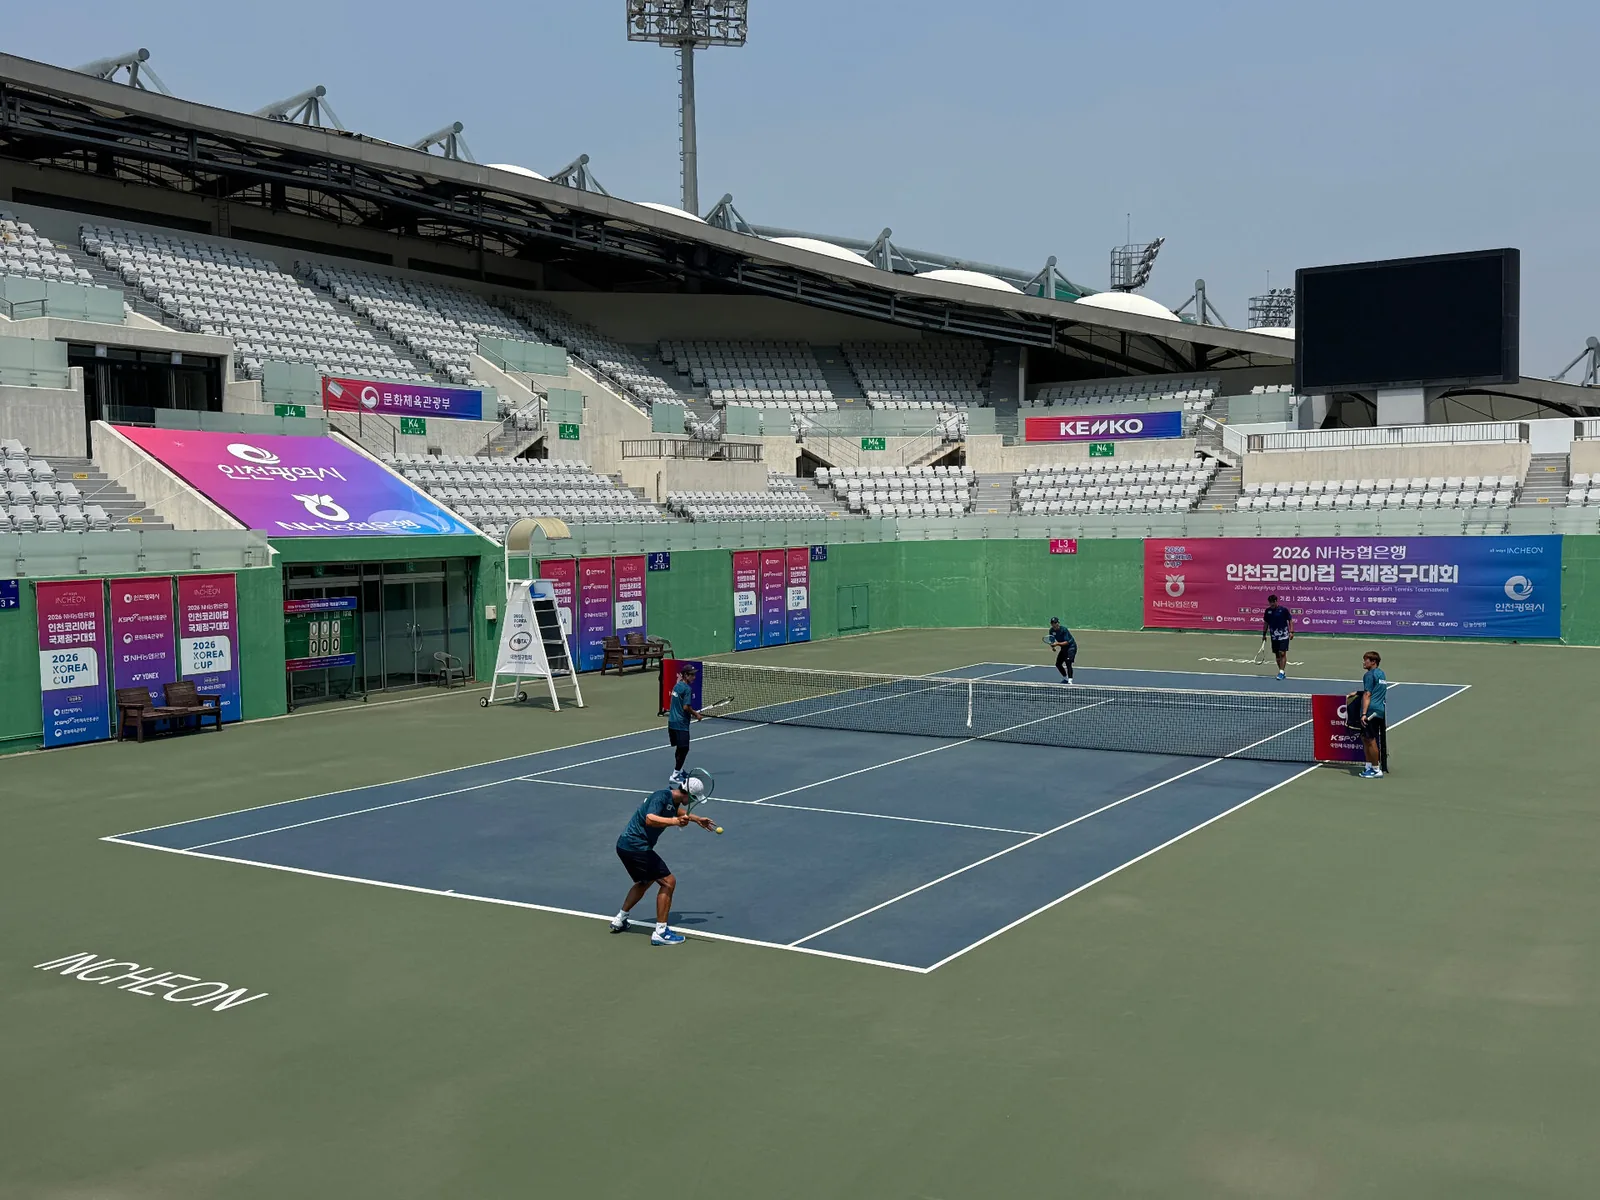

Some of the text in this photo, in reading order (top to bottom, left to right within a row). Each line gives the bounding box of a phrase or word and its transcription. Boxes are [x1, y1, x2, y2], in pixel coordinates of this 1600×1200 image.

[383, 393, 450, 409] 문화체육관광부
[284, 408, 296, 416] J4
[408, 419, 419, 428] K4
[1096, 444, 1107, 452] N4
[218, 464, 347, 482] 인천광역시
[275, 521, 421, 532] NH농협은행
[1058, 539, 1069, 548] L3
[1273, 545, 1407, 560] 2026 NH농협은행
[655, 553, 664, 563] J3
[1226, 563, 1459, 583] 인천코리아컵 국제정구대회
[1152, 600, 1199, 609] NH농협은행
[1495, 603, 1545, 612] 인천광역시
[188, 610, 229, 622] 인천코리아컵
[48, 620, 96, 633] 인천코리아컵
[188, 621, 230, 632] 국제정구대회
[48, 632, 96, 645] 국제정구대회
[193, 641, 216, 650] 2026
[311, 638, 339, 653] 0 0 0
[52, 653, 78, 663] 2026
[193, 650, 224, 660] KOREA
[53, 663, 88, 674] KOREA
[193, 661, 213, 669] CUP
[53, 675, 75, 685] CUP
[142, 672, 159, 680] YONEX
[1330, 734, 1357, 742] KSPO
[33, 951, 269, 1012] INCHEON
